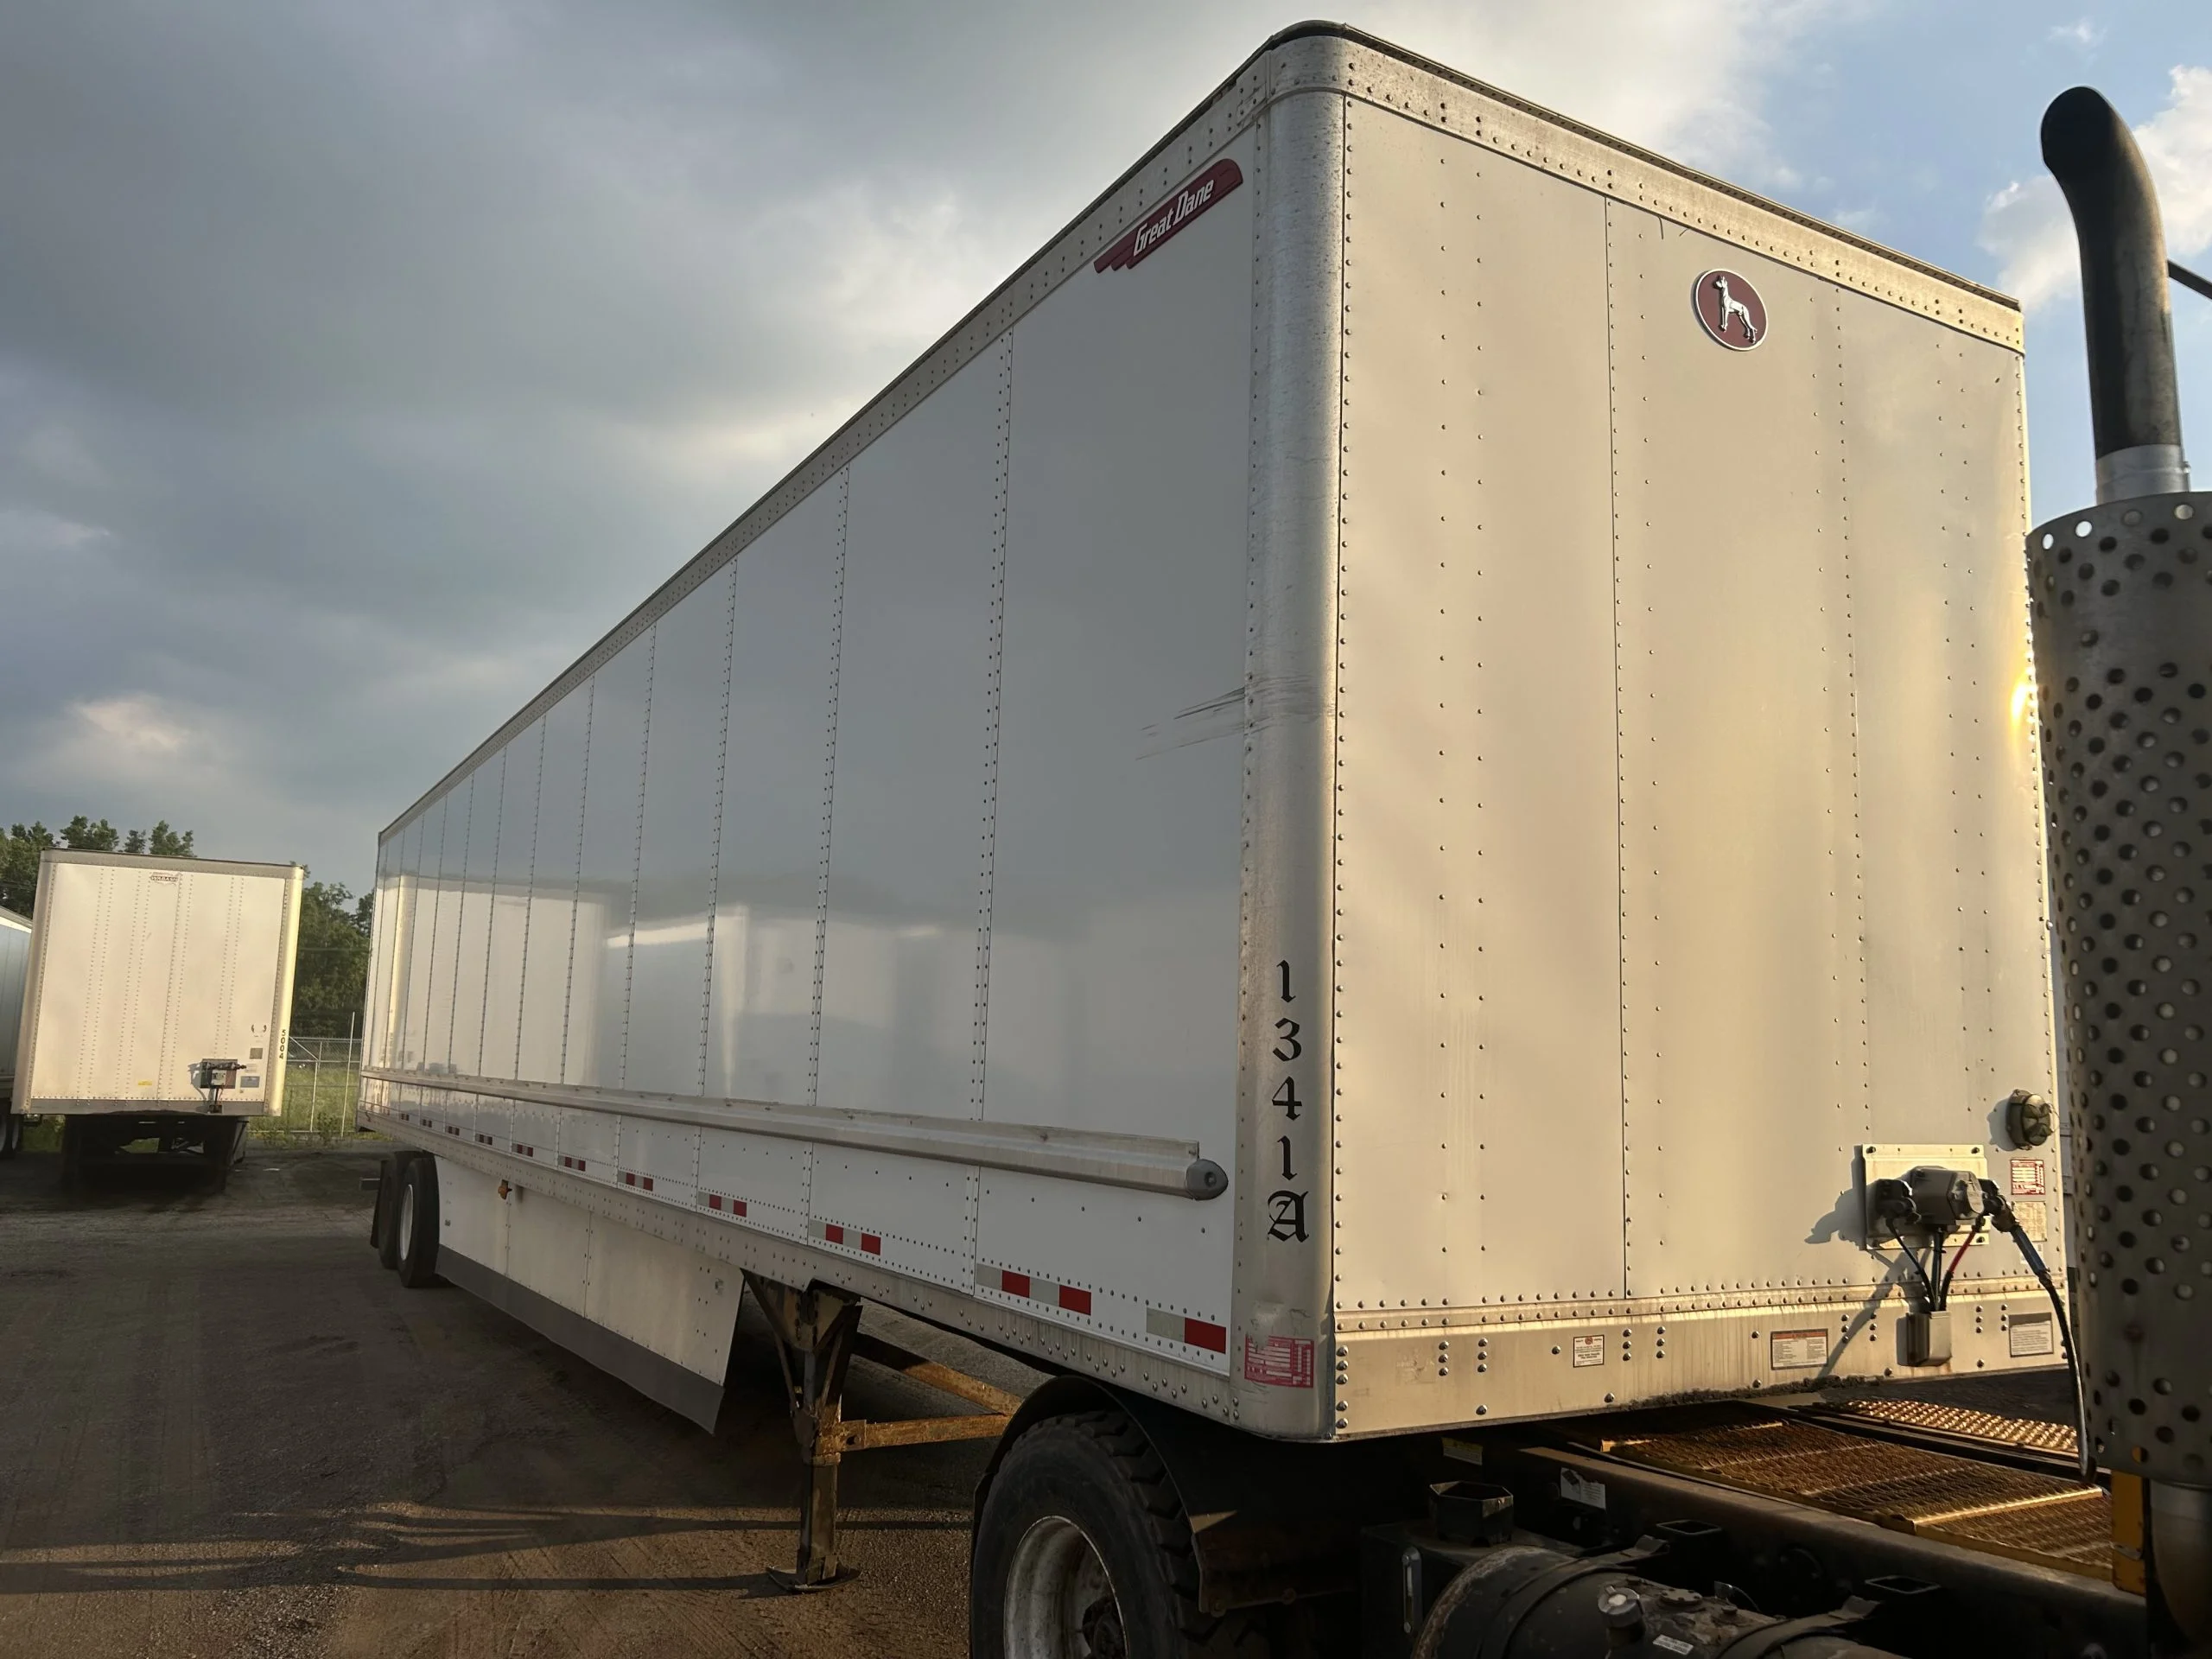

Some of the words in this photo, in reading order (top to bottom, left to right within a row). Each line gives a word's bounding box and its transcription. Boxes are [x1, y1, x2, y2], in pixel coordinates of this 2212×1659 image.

[1133, 207, 1174, 257] Great
[1173, 180, 1214, 226] Dane
[1267, 959, 1309, 1243] 1341A
